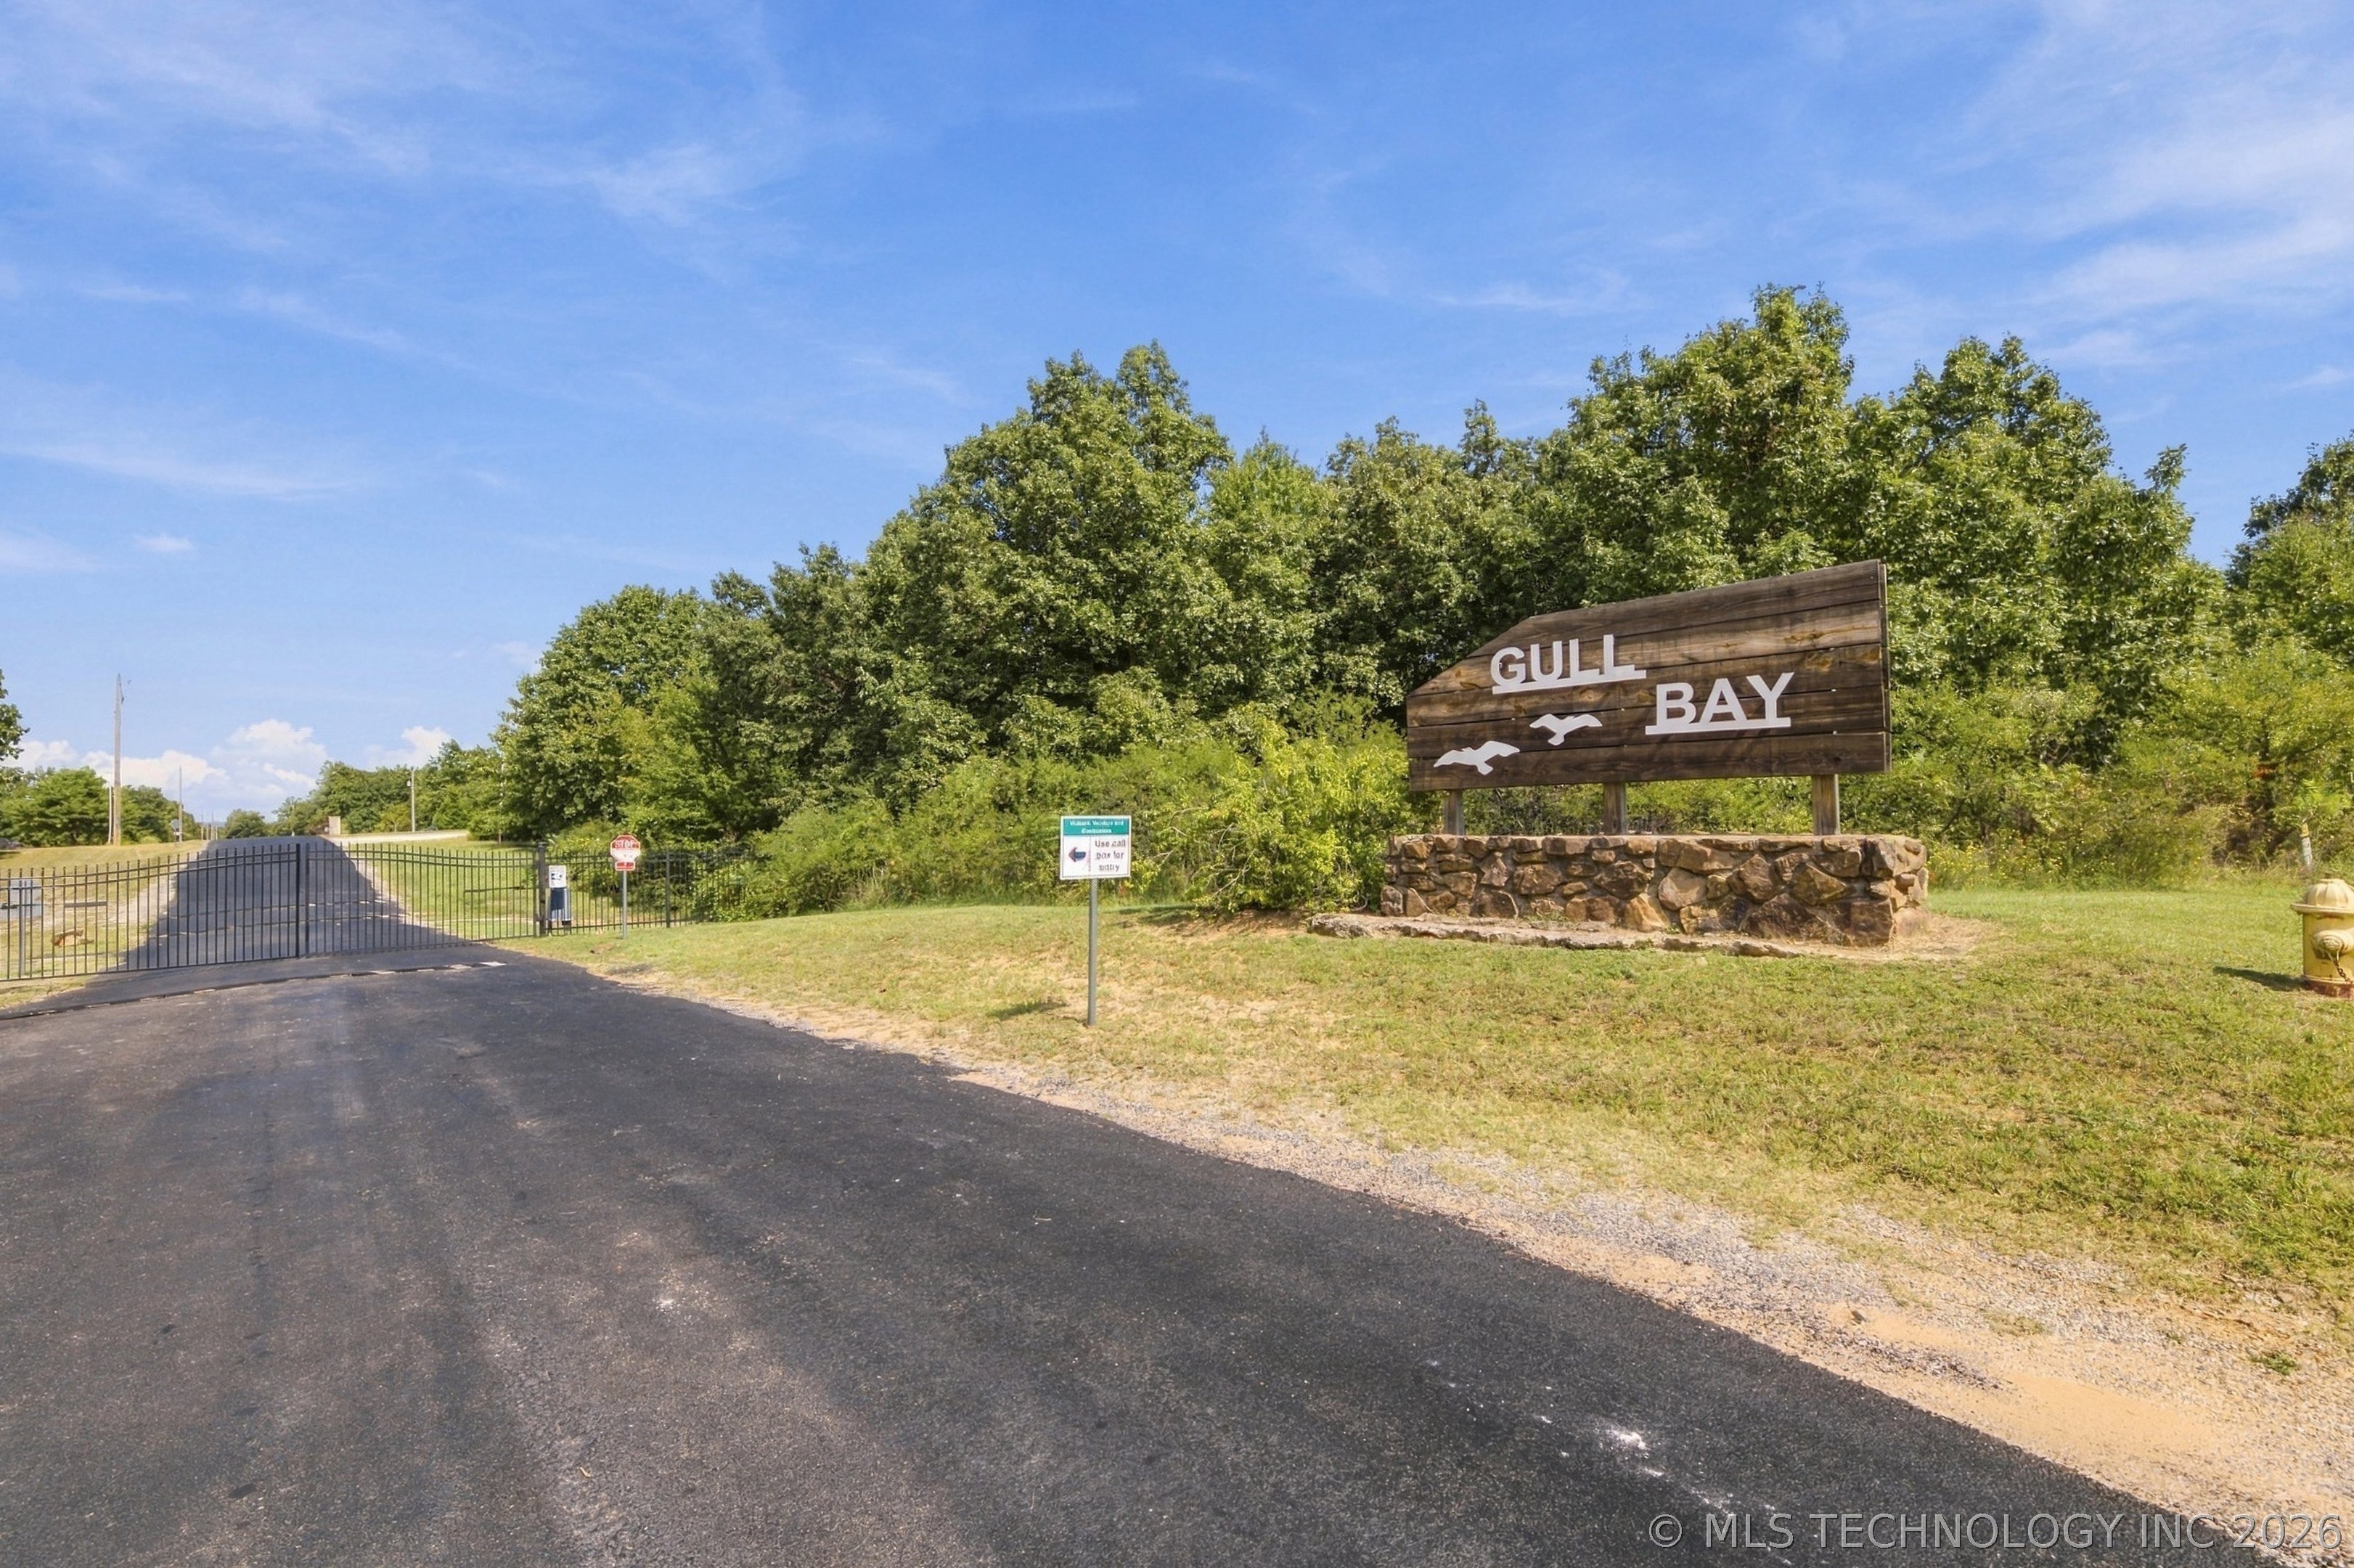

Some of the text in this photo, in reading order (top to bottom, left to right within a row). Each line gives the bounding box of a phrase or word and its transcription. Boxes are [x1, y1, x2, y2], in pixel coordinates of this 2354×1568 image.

[1490, 634, 1638, 688] GULL
[1655, 672, 1794, 727] BAY
[615, 839, 637, 849] STOP
